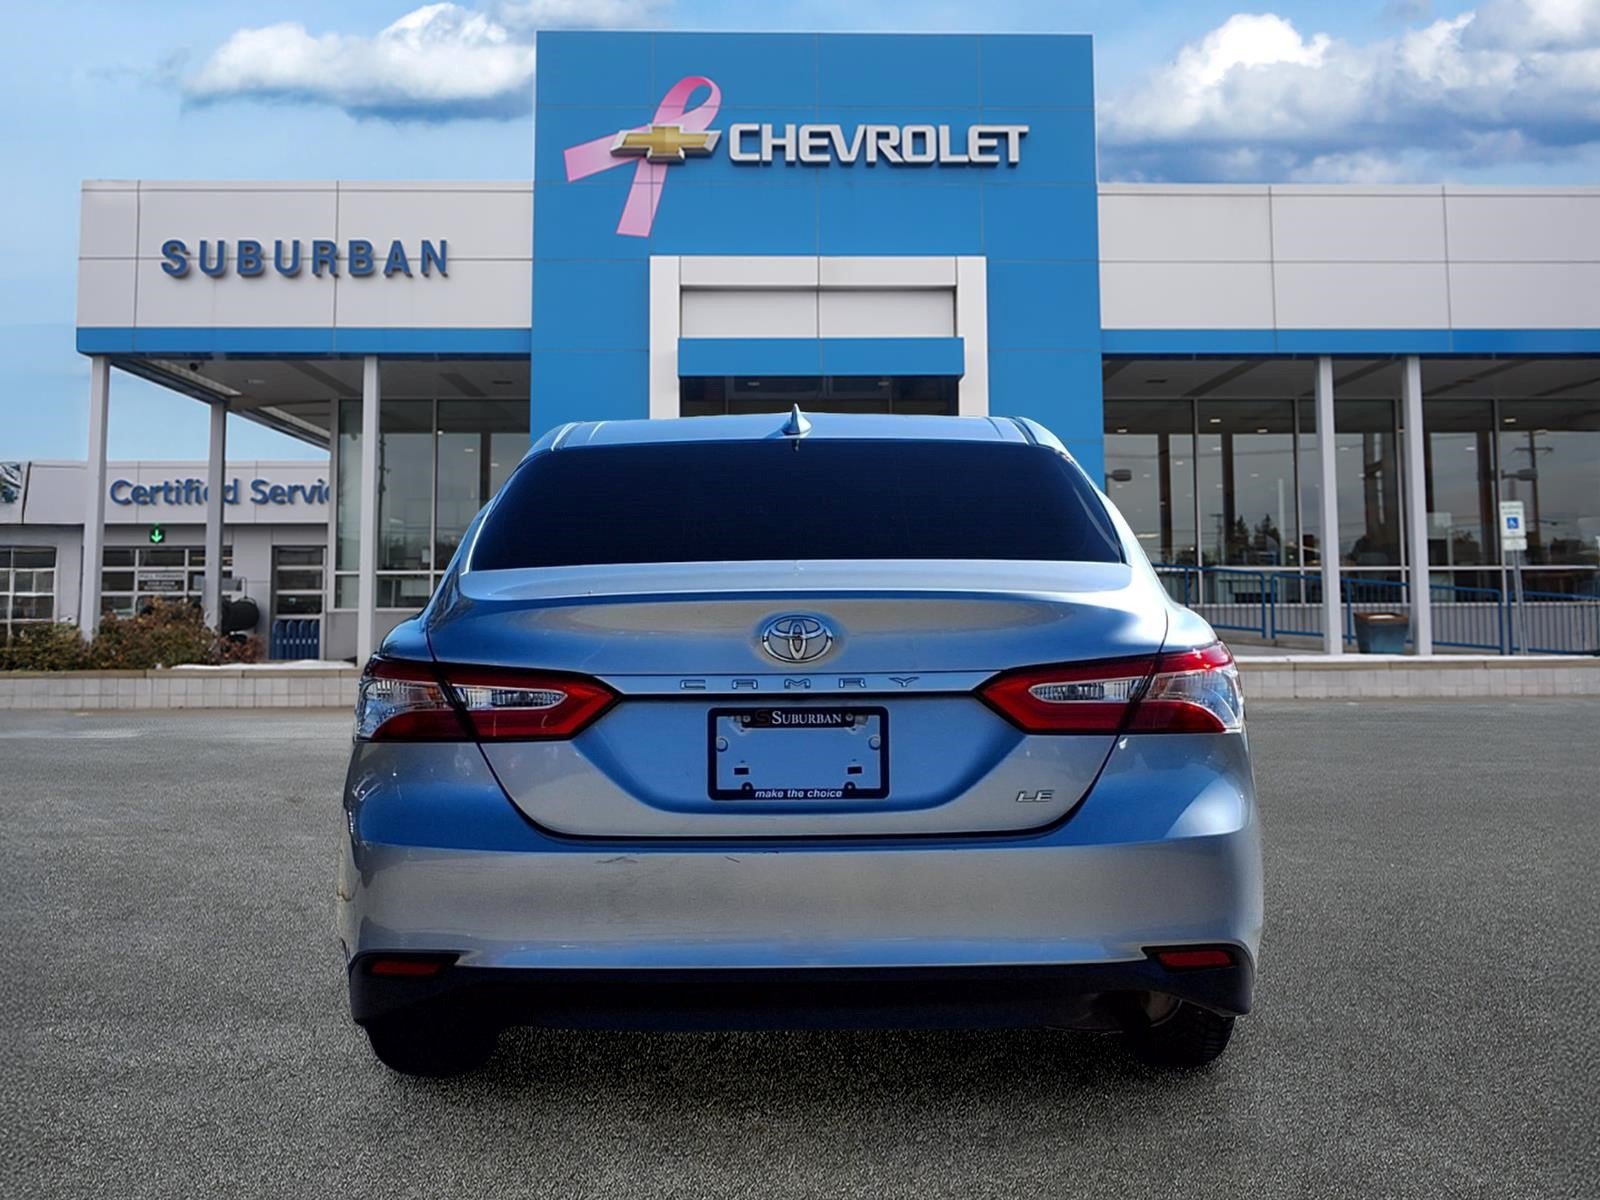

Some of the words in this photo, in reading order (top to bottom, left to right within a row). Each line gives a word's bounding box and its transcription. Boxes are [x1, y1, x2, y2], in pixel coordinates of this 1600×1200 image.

[729, 123, 1030, 165] CHEVROLET
[160, 239, 449, 279] SUBURBAN
[110, 478, 240, 505] Certifid
[679, 676, 921, 690] CAMRY
[755, 789, 784, 798] make
[787, 789, 804, 798] the
[807, 789, 843, 798] choice
[1016, 789, 1055, 803] LE
